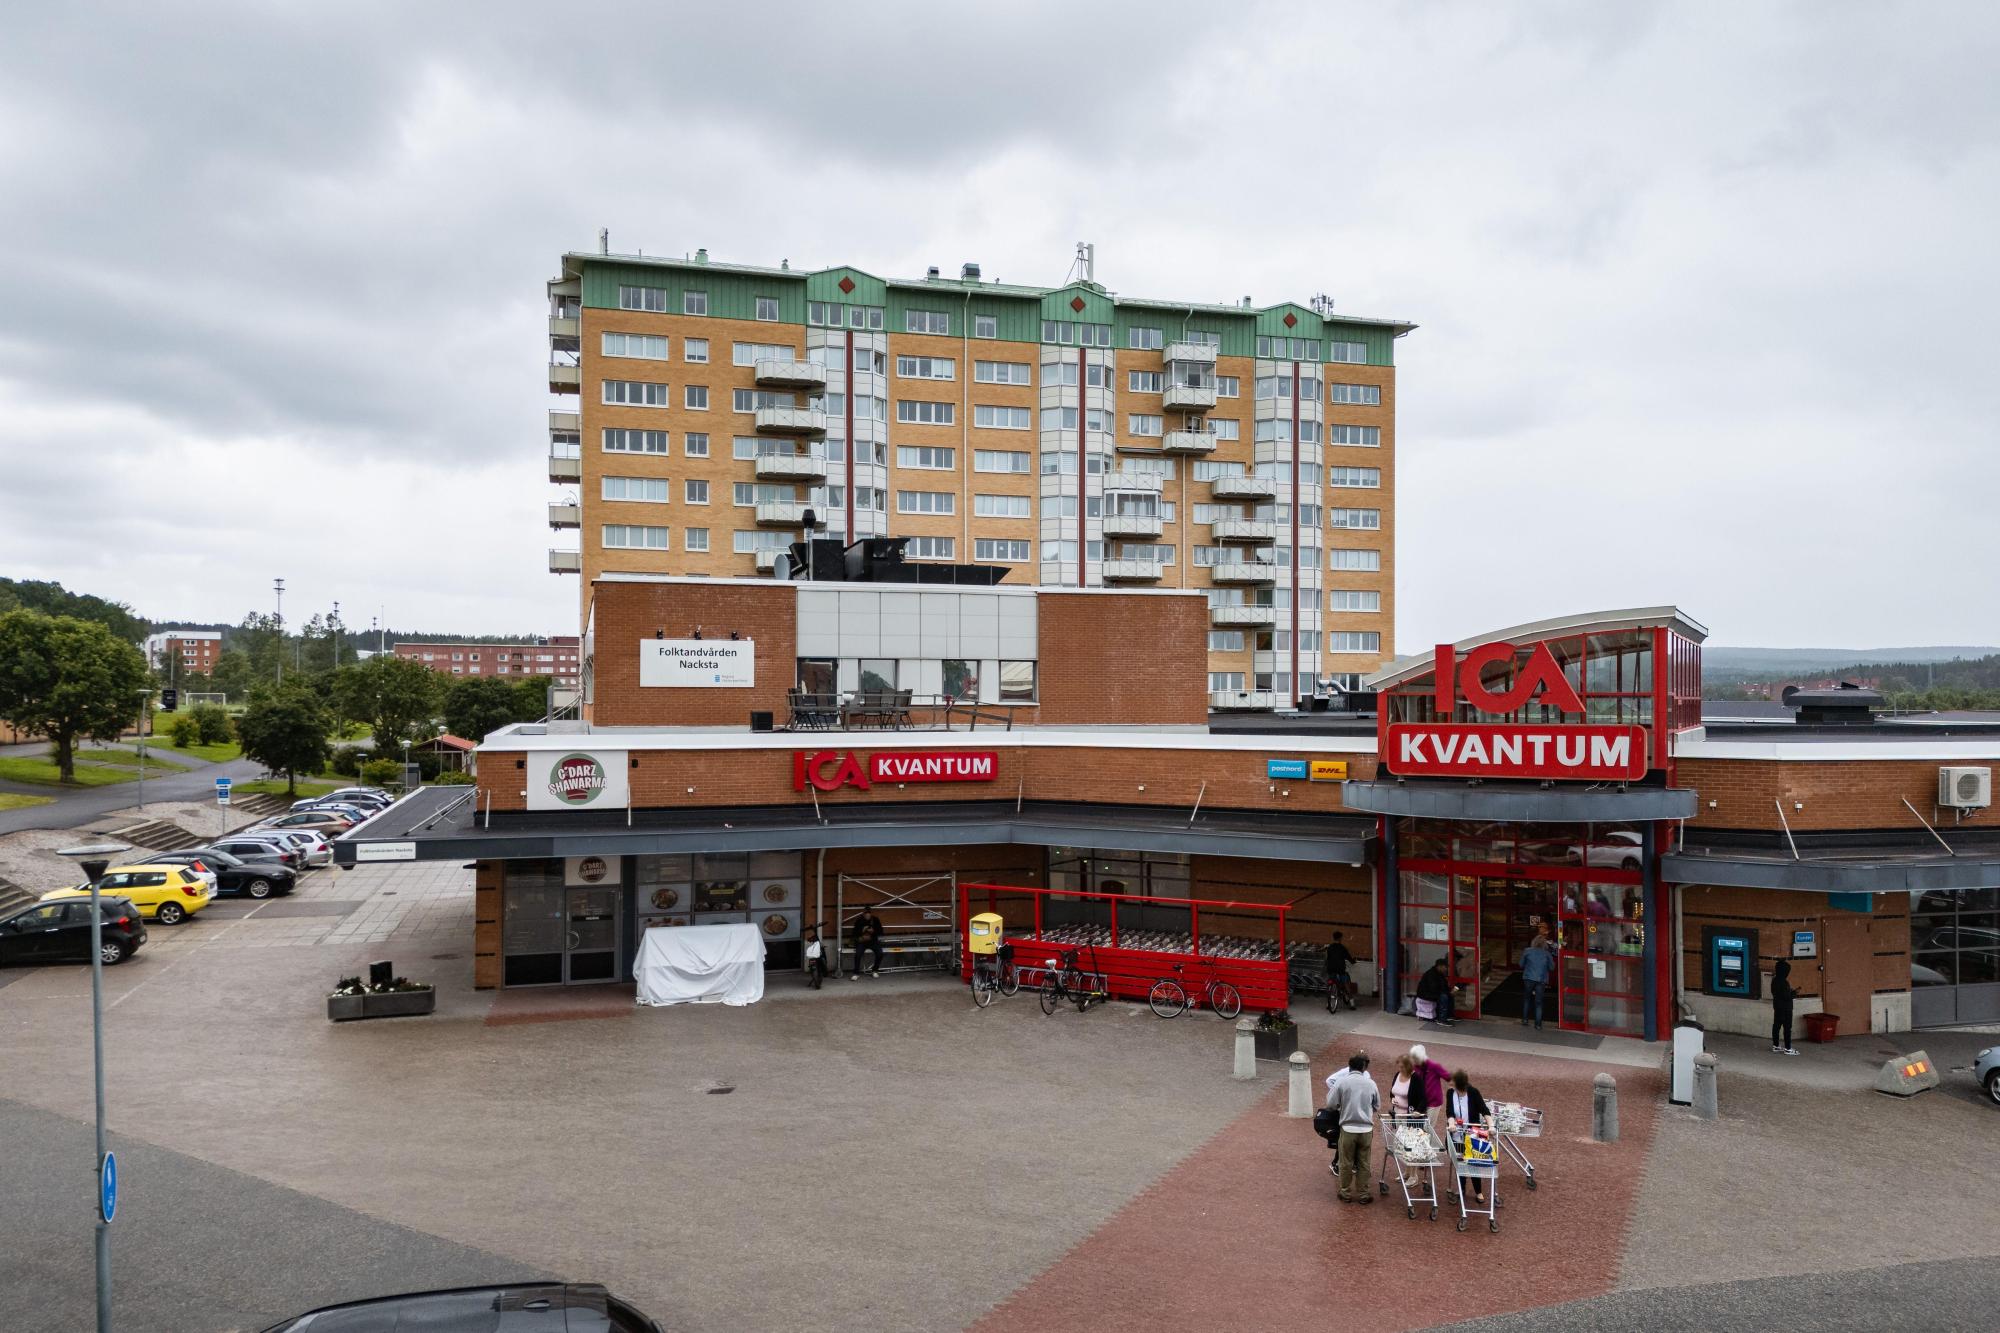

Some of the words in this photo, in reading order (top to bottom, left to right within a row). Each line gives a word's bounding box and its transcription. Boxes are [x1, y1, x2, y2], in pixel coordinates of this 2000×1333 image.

[659, 647, 737, 657] Folktandvården
[679, 660, 719, 669] Nacksta
[1435, 639, 1586, 714] ICA
[1400, 733, 1630, 767] KVANTUM
[794, 751, 871, 792] ICA
[878, 758, 991, 776] KVANTUM
[548, 776, 608, 795] SHAWARMA
